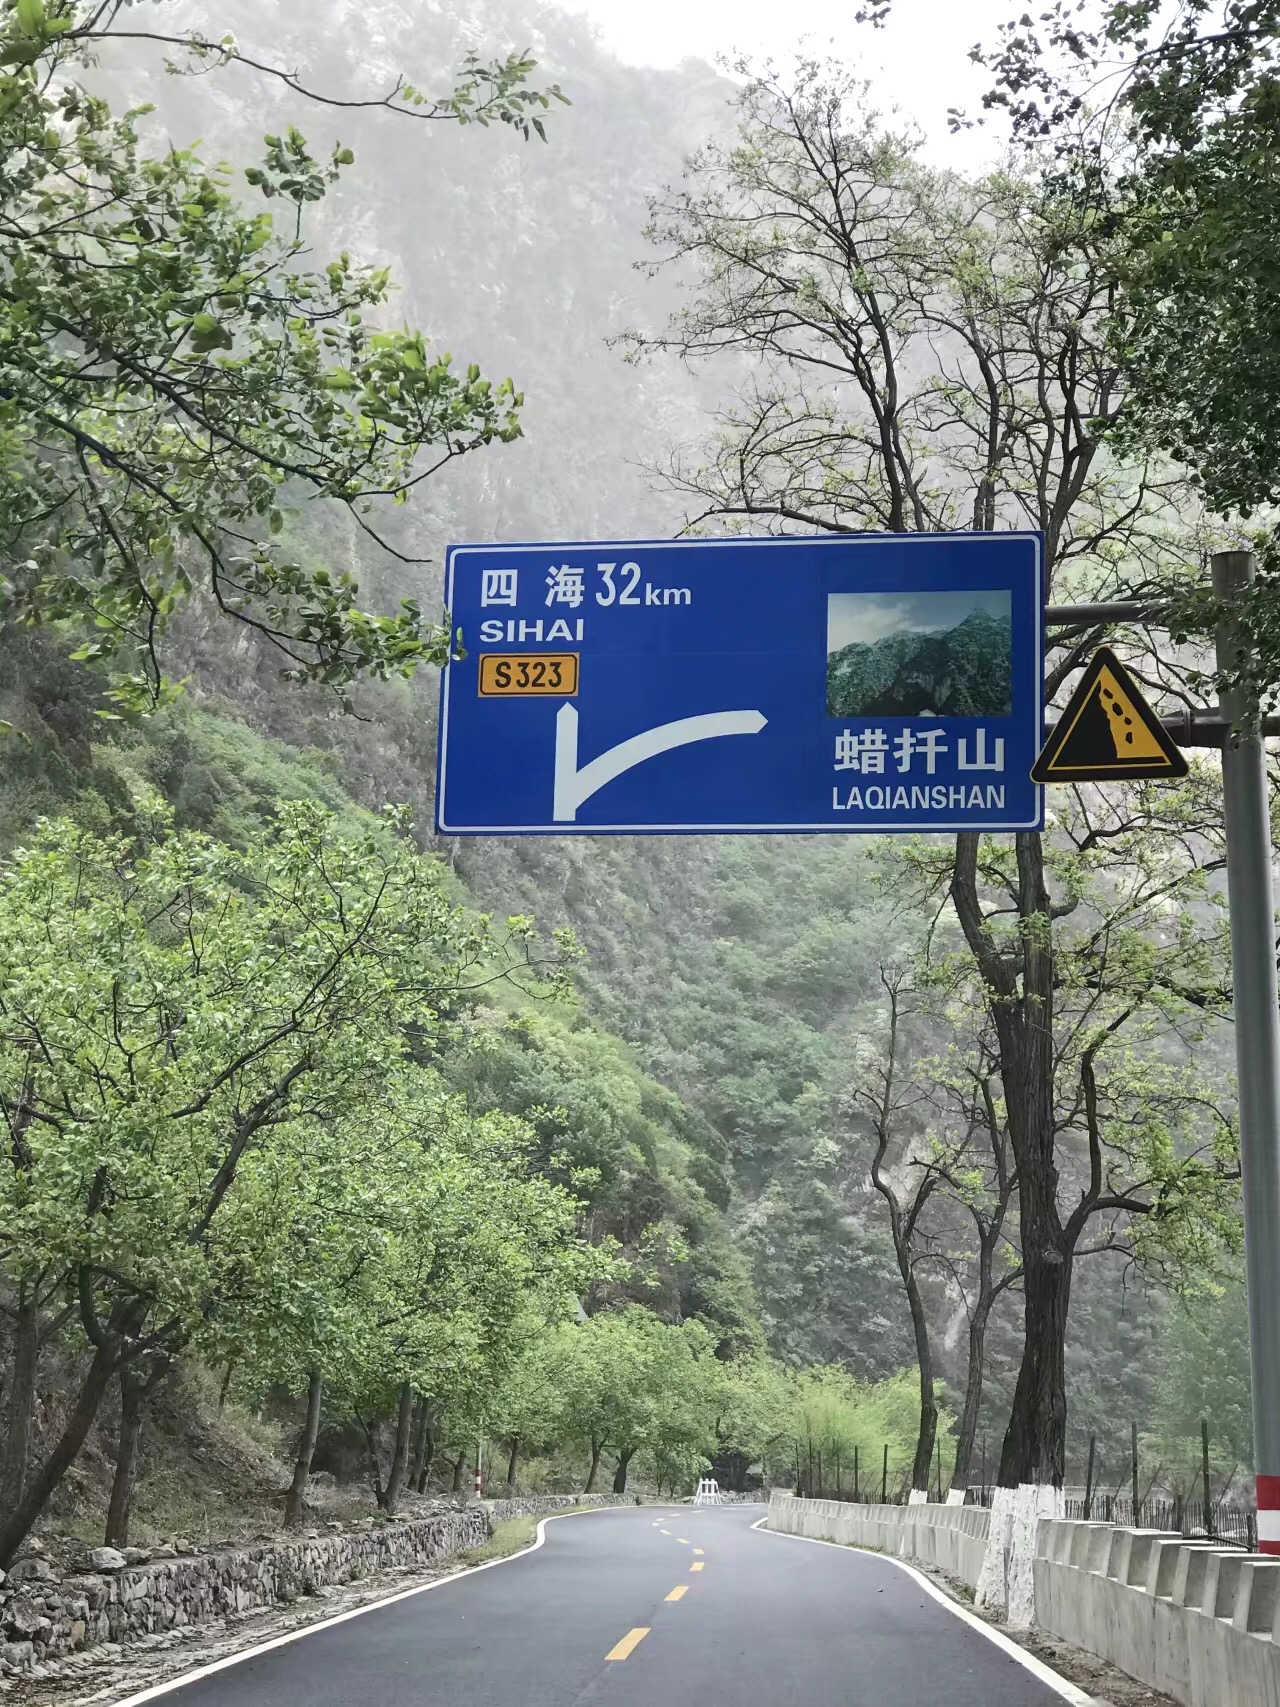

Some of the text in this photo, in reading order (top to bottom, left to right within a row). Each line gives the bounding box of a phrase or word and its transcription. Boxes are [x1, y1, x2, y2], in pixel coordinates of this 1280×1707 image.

[479, 618, 585, 643] SIHAI
[494, 661, 563, 689] S323
[833, 728, 1005, 775] 蜡扦山
[832, 784, 1006, 811] LAQIANSHAN
